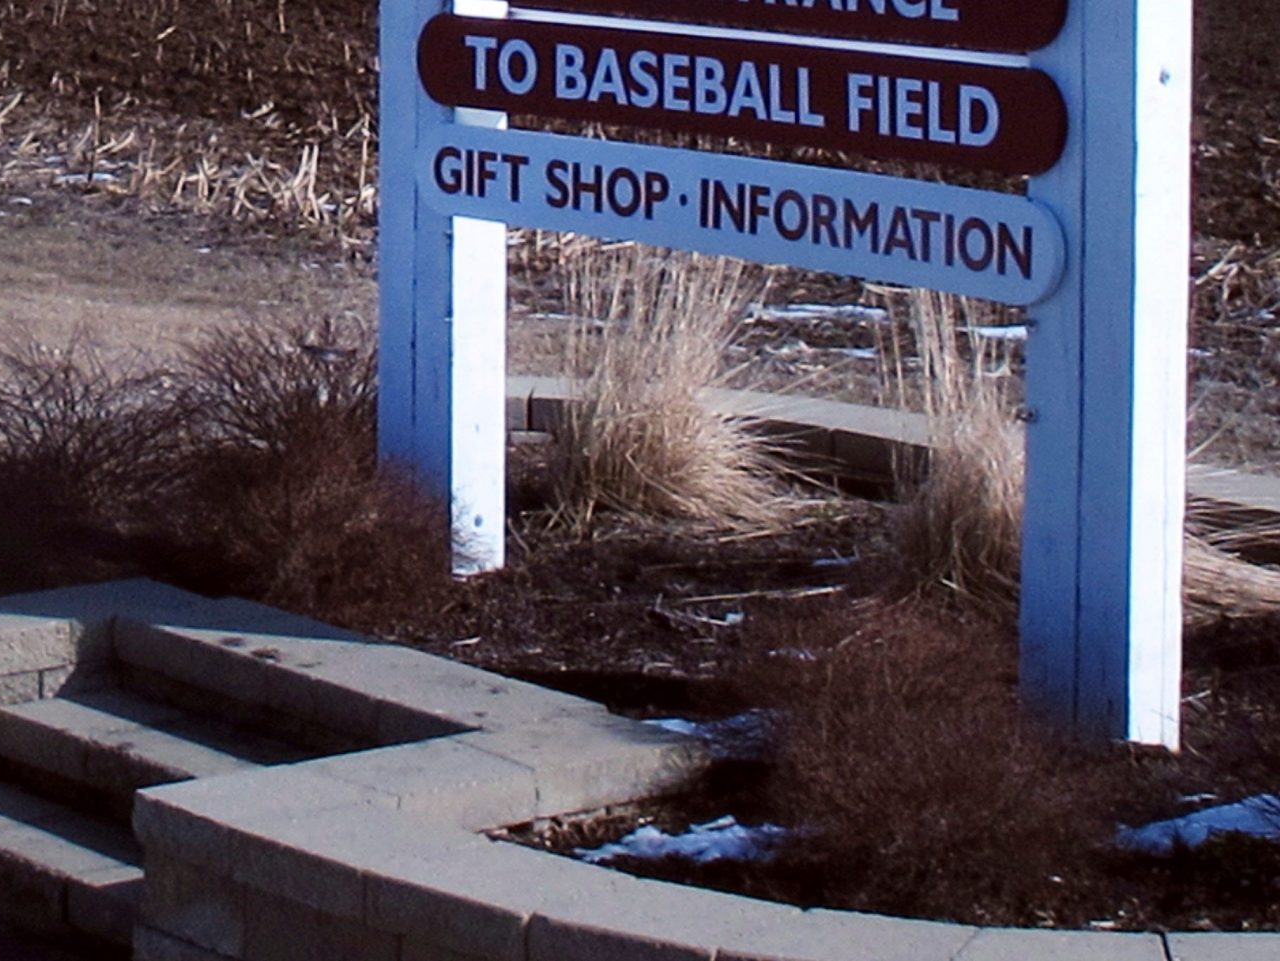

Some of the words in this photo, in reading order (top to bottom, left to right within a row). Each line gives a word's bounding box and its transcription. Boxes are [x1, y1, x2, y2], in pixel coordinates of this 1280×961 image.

[465, 35, 538, 95] TO
[555, 44, 825, 128] BASEBALL
[847, 73, 1000, 147] FIELD
[433, 145, 529, 200] GIFT
[699, 177, 1033, 280] INFORMATION
